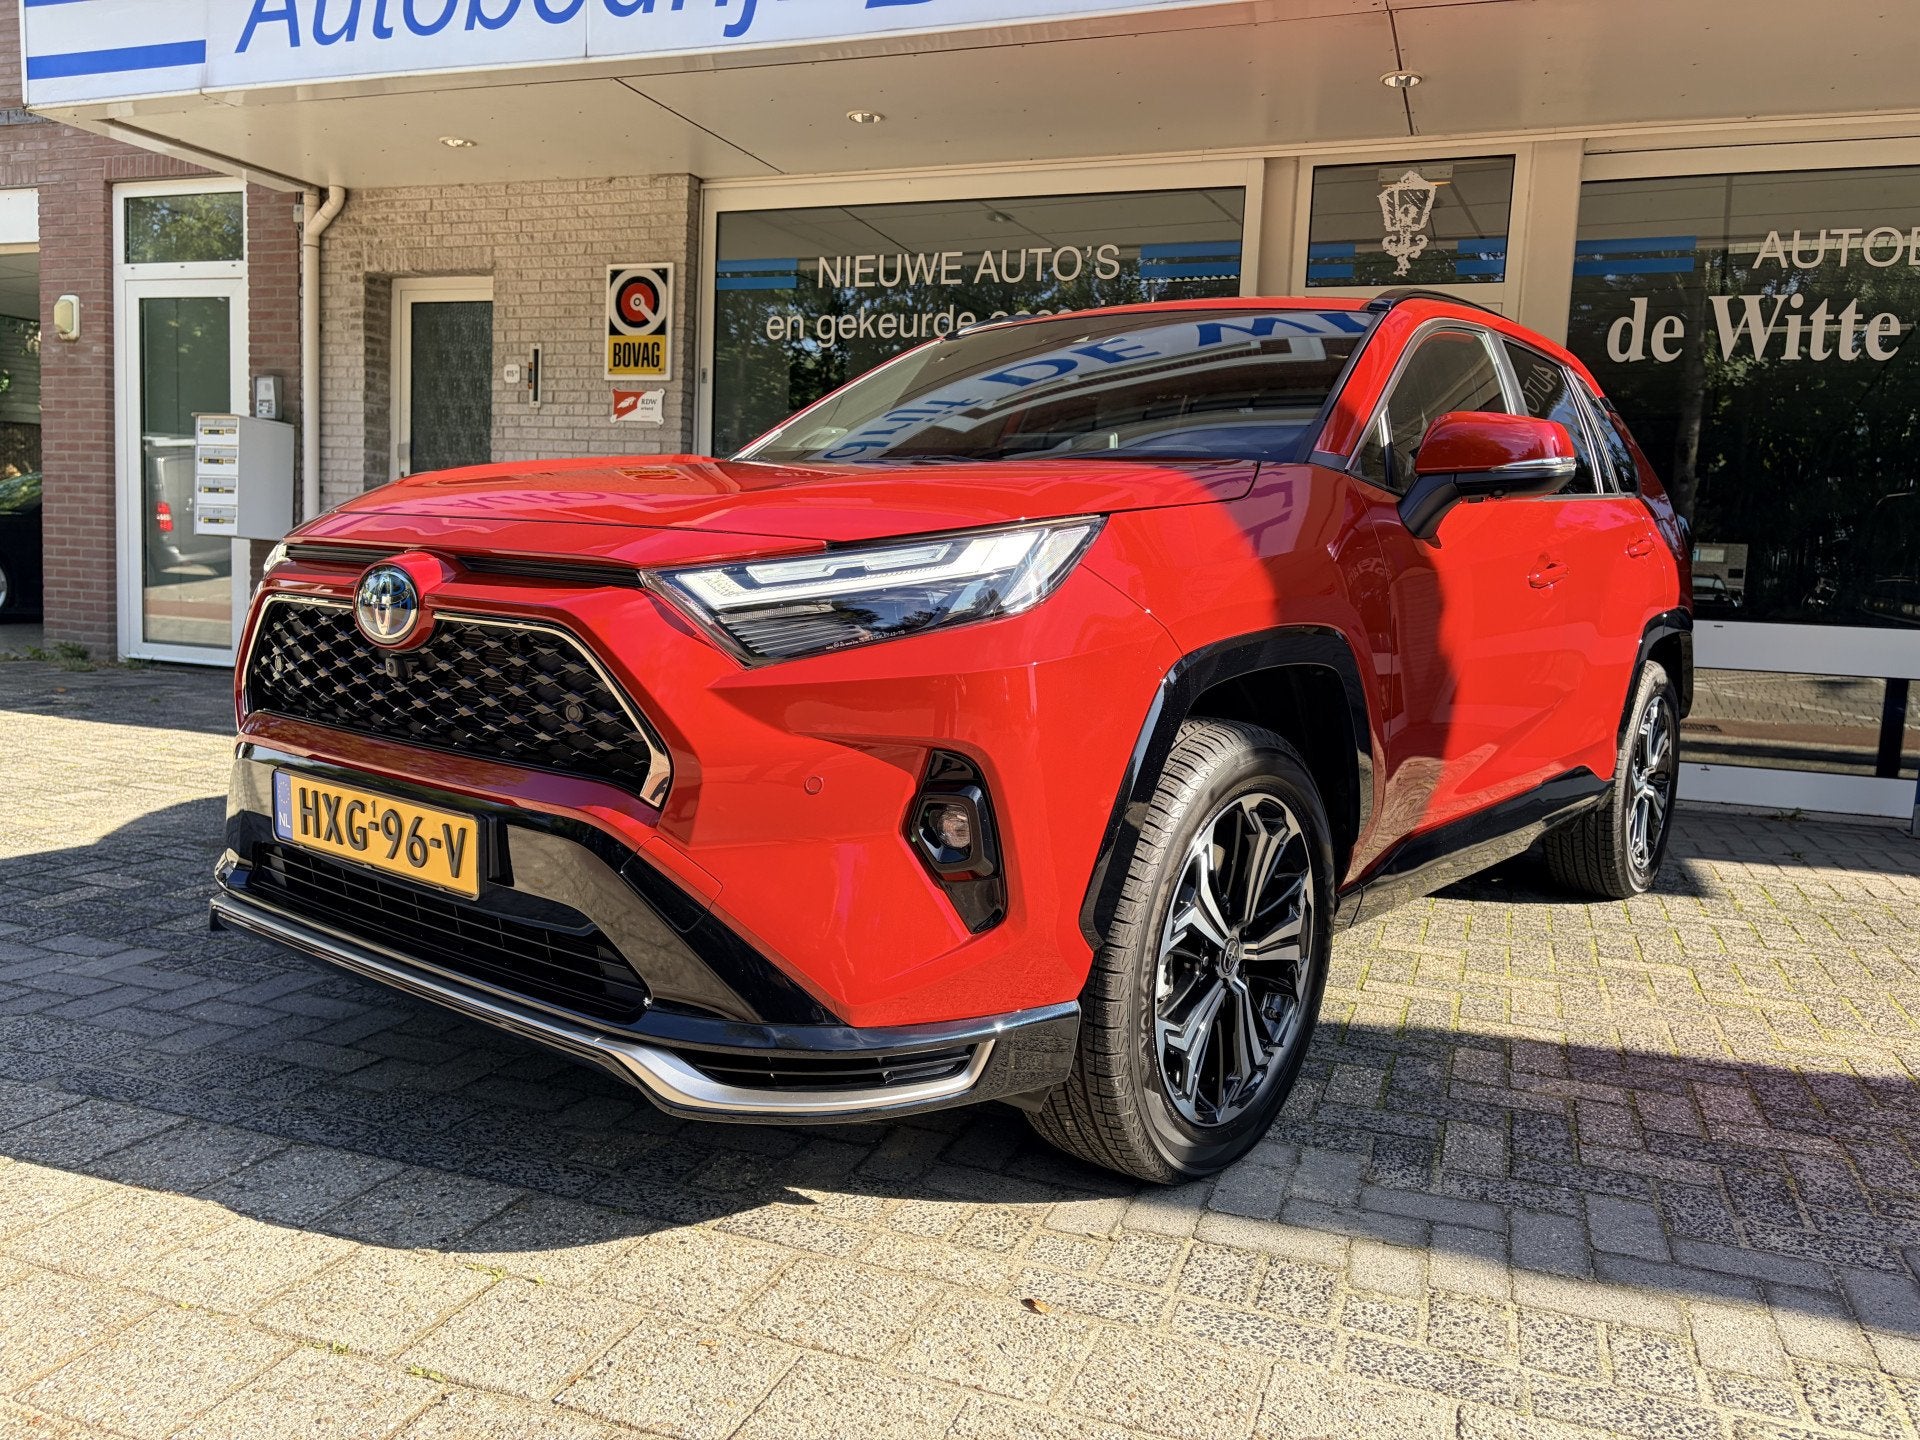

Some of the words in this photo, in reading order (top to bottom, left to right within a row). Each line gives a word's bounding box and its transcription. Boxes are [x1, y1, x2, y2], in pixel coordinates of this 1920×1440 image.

[817, 251, 963, 289] NIEUWE
[973, 244, 1121, 284] AUTO'S
[766, 313, 804, 340] en
[816, 304, 977, 348] gekeurde
[1606, 297, 1686, 363] de
[1708, 292, 1901, 362] Witte
[612, 342, 661, 368] BOVAG
[278, 811, 291, 829] NL
[298, 787, 467, 879] HXG-96-V
